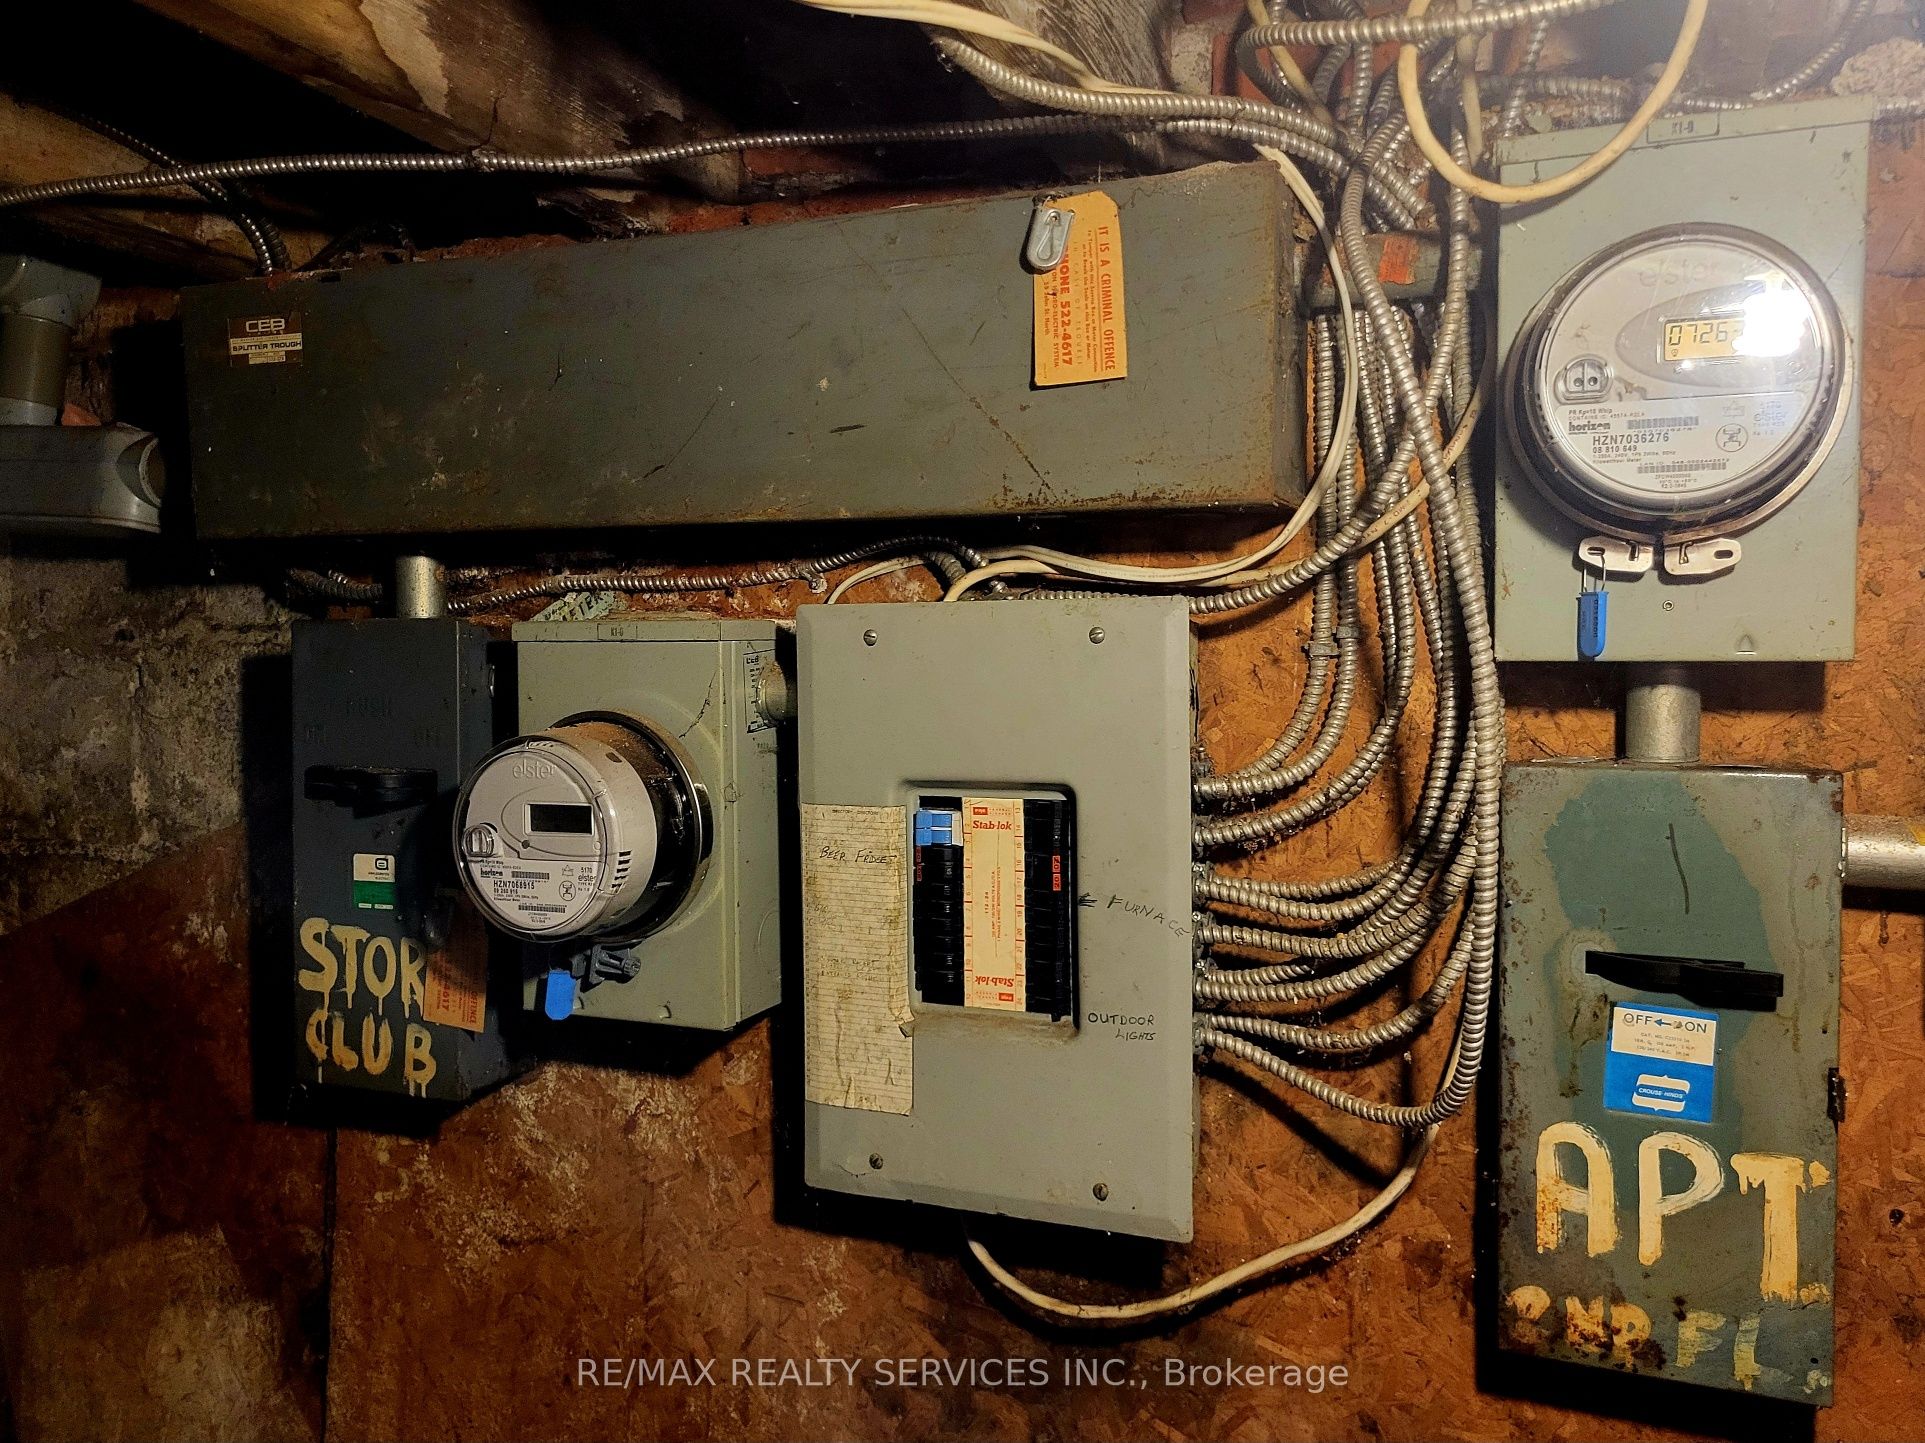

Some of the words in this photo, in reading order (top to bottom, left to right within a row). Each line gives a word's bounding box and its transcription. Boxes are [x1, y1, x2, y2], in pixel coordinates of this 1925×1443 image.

[1098, 226, 1109, 236] IT
[1100, 242, 1110, 253] IS
[1060, 247, 1070, 295] HONE
[1100, 259, 1111, 267] A
[1101, 273, 1113, 323] CRIMINAL
[1060, 301, 1073, 366] 522-4617
[270, 341, 302, 349] TROUGH
[1103, 329, 1116, 371] OFFENCE
[1592, 432, 1670, 446] HZN7036276
[513, 759, 556, 779] elster
[819, 845, 846, 861] BEER
[1107, 894, 1191, 938] FURNACE
[1087, 1012, 1155, 1026] OUTDOOR
[1623, 1012, 1653, 1026] OFF
[1684, 1021, 1708, 1034] ON
[1115, 1028, 1156, 1041] LIGHTS
[305, 1008, 437, 1092] CLUB
[1638, 1087, 1662, 1097] CROUSE
